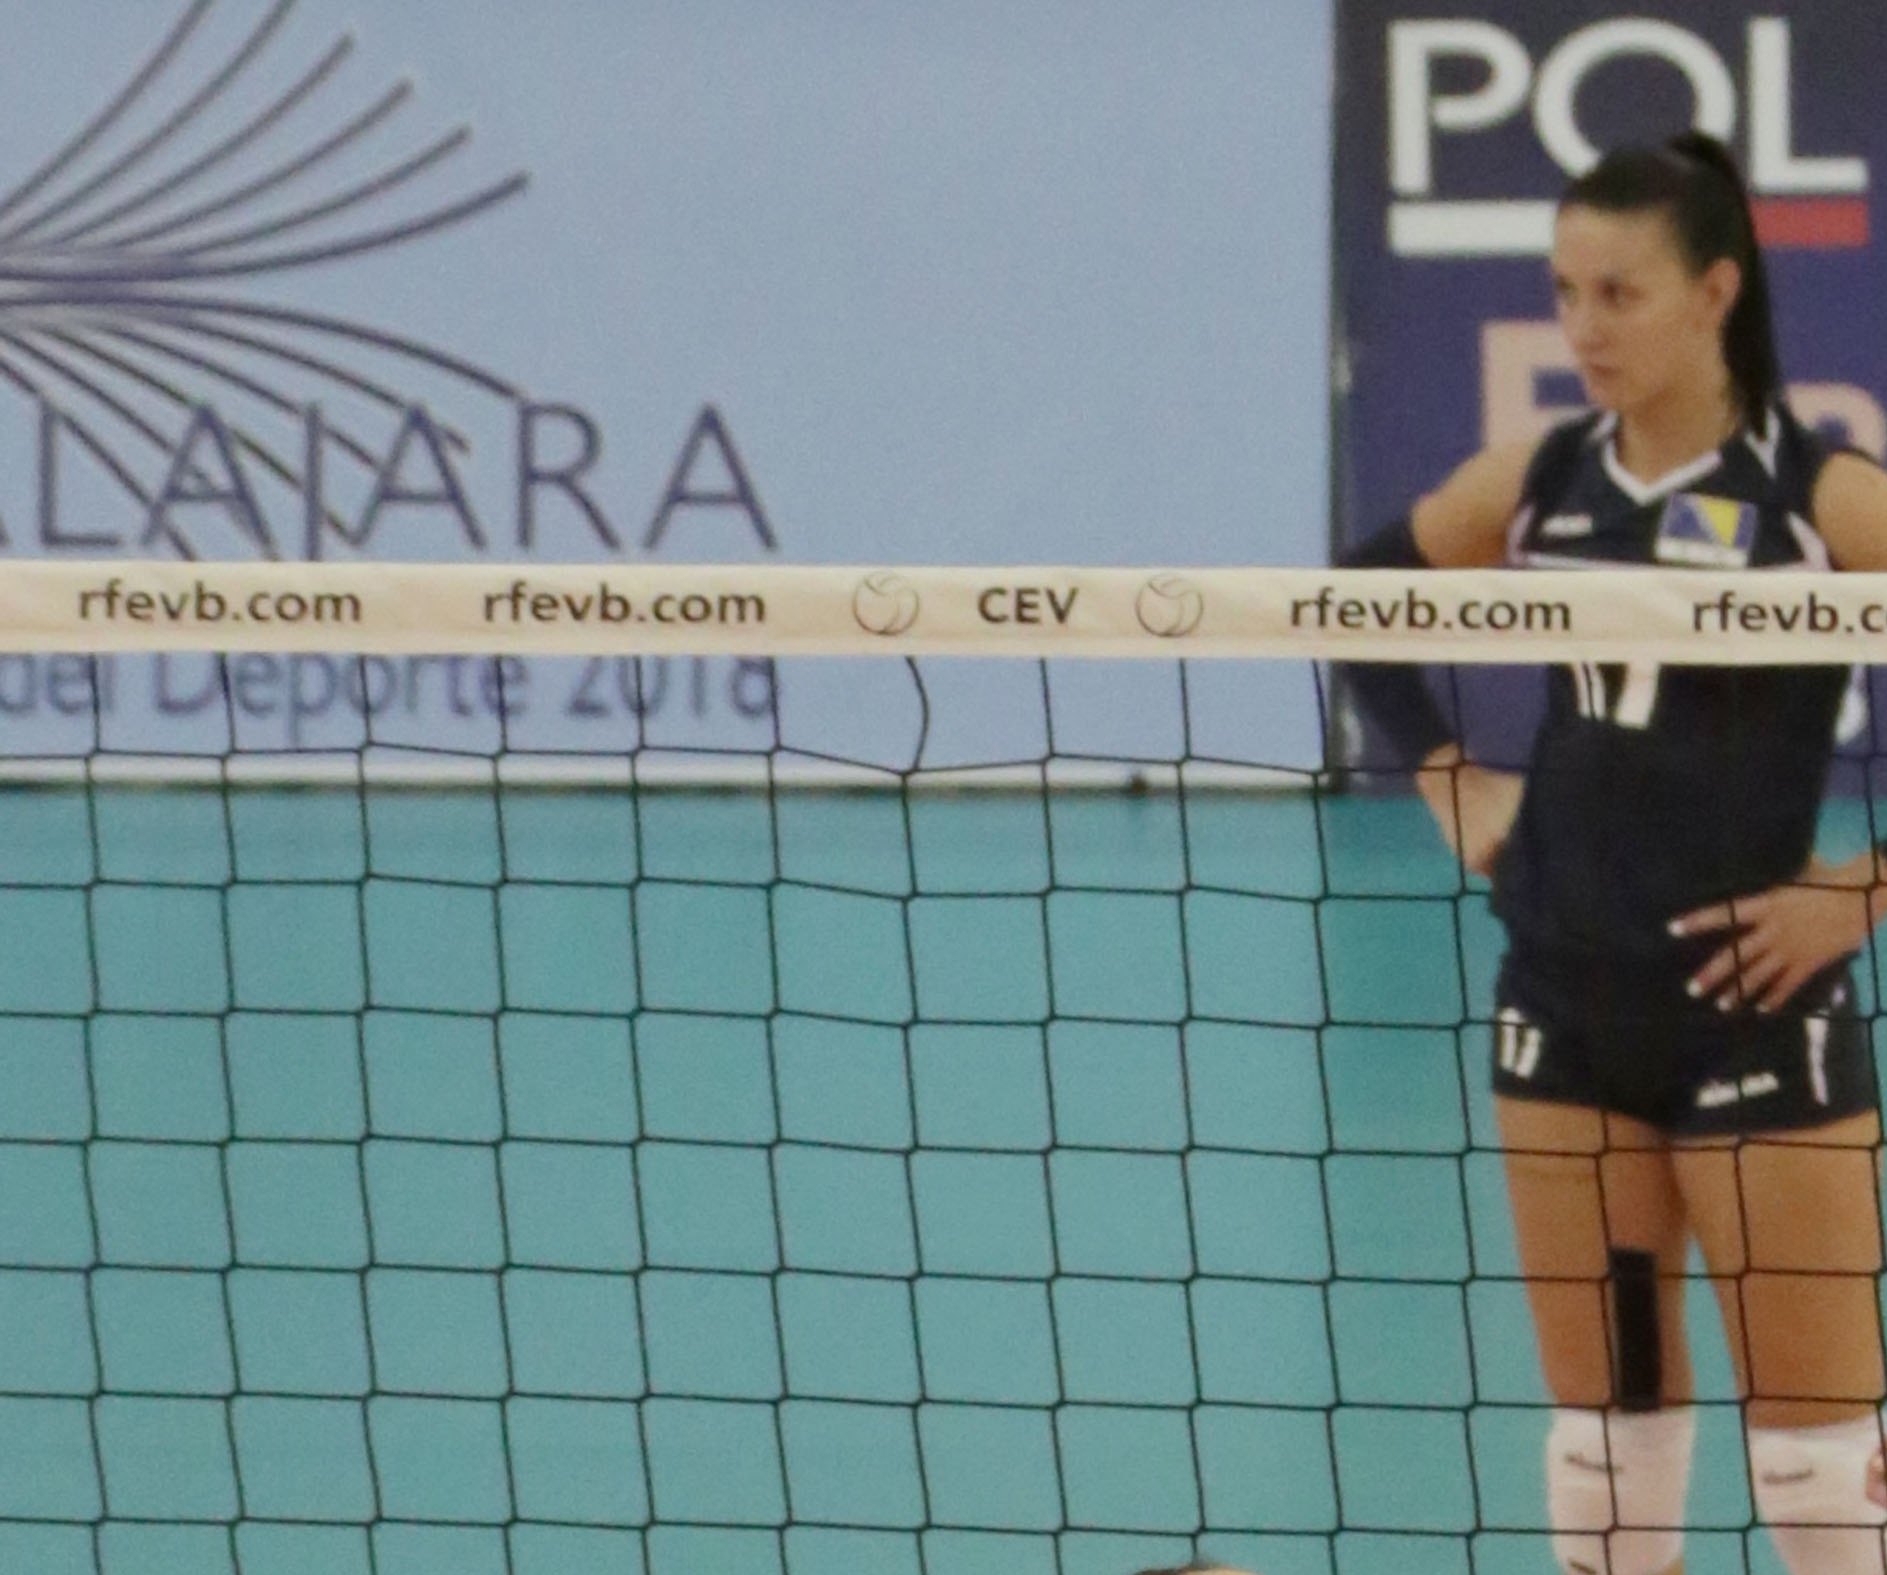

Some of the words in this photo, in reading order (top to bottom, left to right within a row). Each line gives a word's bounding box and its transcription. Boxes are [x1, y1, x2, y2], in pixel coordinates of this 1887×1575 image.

[1388, 16, 1868, 194] POL
[0, 402, 779, 560] LAJARA
[79, 577, 363, 624] rfevb.com
[483, 579, 767, 625] rfevb.com
[976, 586, 1078, 626] CEV
[1290, 586, 1572, 632] rfevb.com
[156, 652, 530, 750] Deporte
[566, 654, 783, 718] 2018
